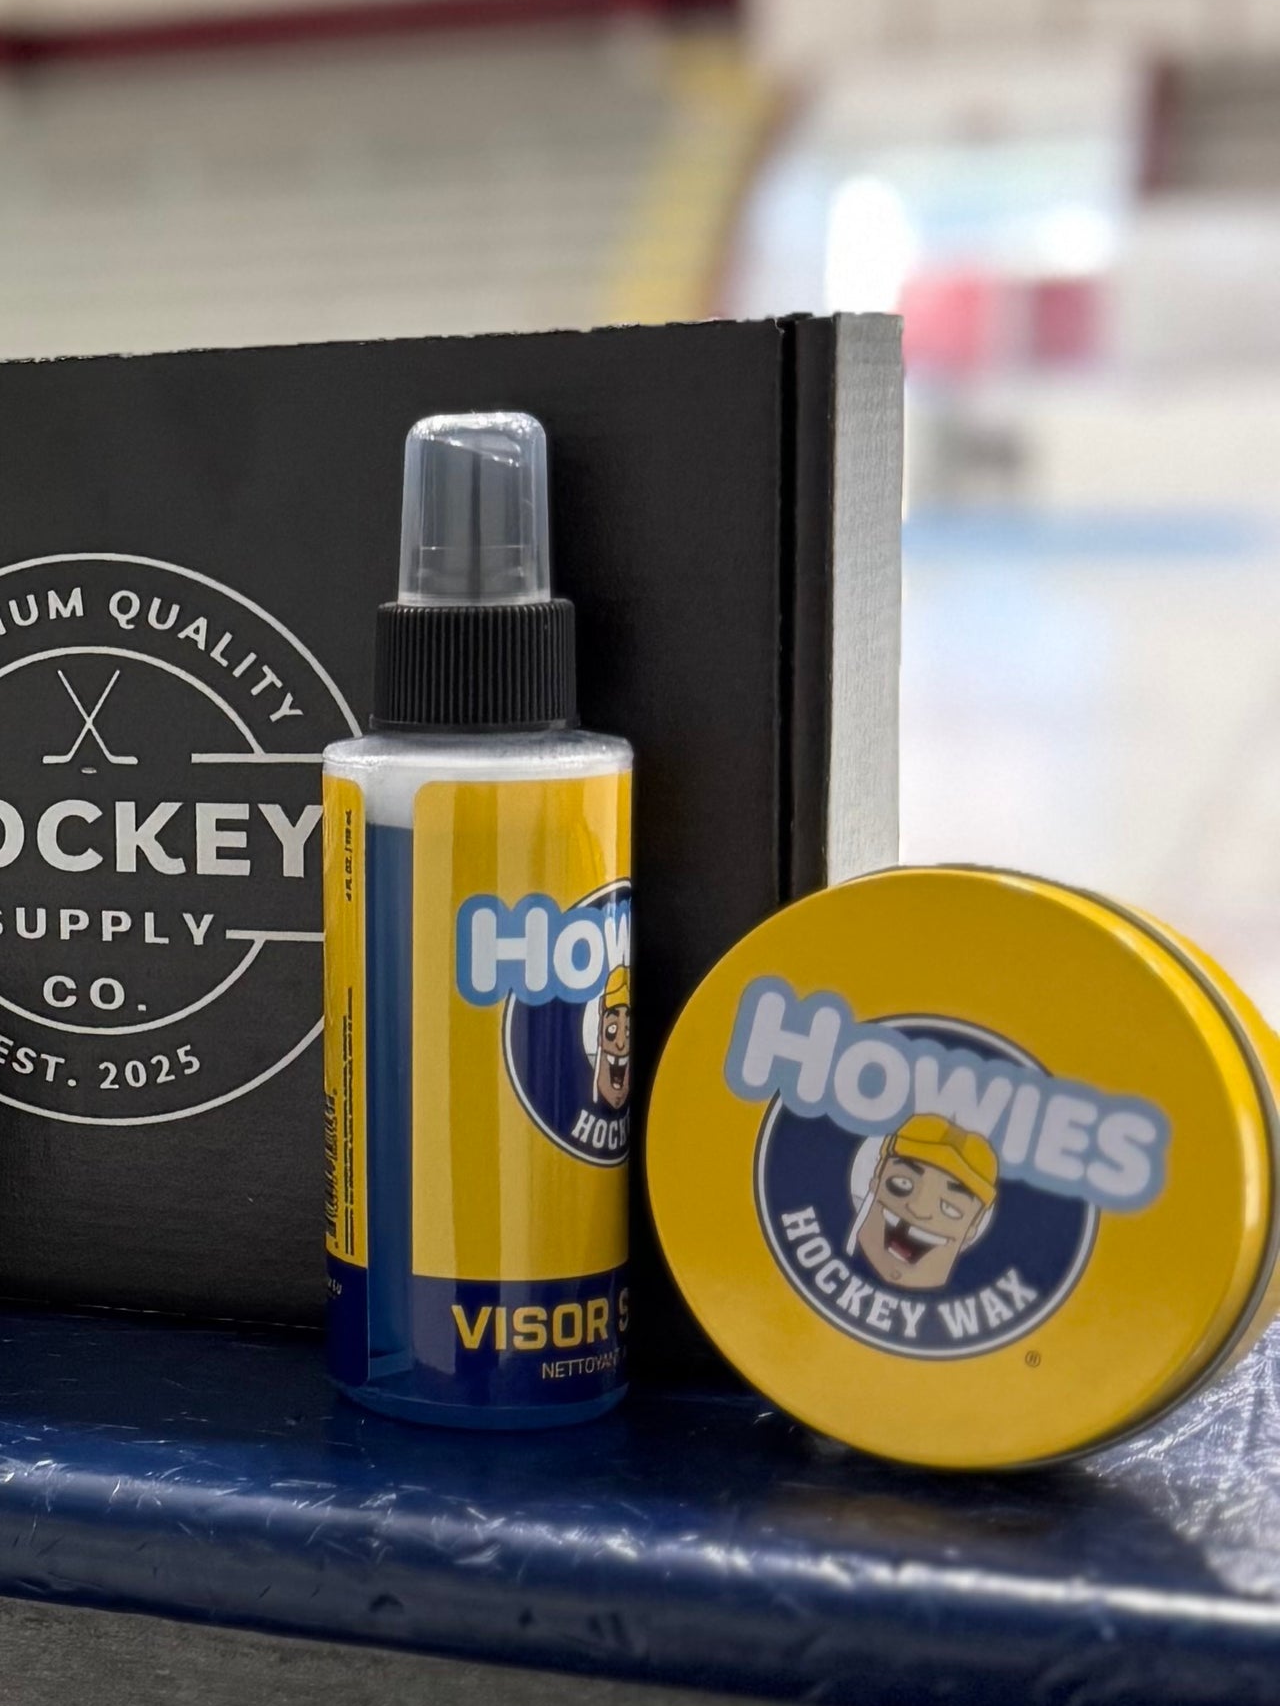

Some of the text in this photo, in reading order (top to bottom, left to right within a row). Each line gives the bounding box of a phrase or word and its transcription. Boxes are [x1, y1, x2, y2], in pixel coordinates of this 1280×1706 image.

[108, 590, 303, 725] QUALITY
[43, 975, 147, 1011] CO.
[98, 1044, 201, 1089] 2025
[743, 991, 1158, 1197] HOWIES
[781, 1205, 1038, 1340] HOCKEY WAX
[451, 1297, 609, 1350] VISOR
